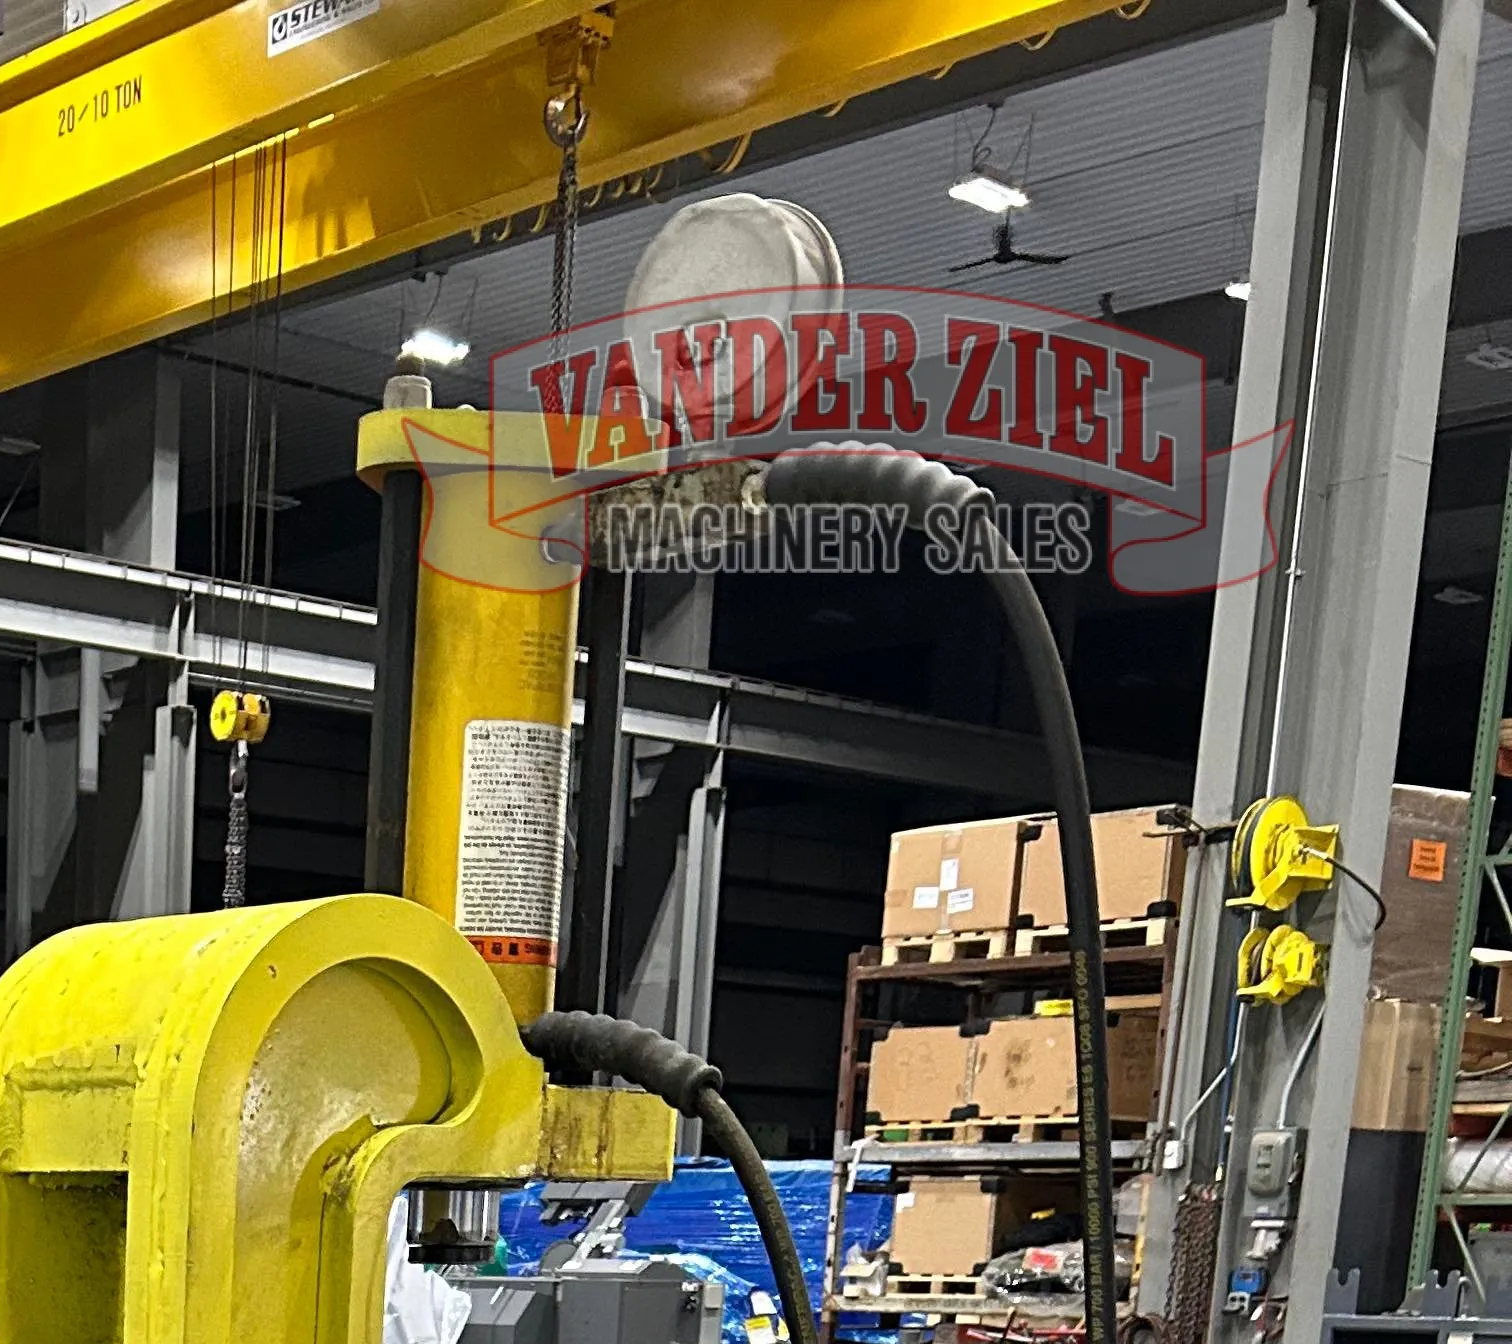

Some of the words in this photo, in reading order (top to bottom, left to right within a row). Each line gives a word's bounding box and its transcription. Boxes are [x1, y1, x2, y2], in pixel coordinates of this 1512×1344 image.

[115, 75, 142, 112] TON
[1081, 1086, 1096, 1141] SERIES
[1085, 1173, 1099, 1198] PSI
[1086, 1202, 1101, 1241] 10000
[1088, 1253, 1102, 1285] BAR
[1090, 1288, 1104, 1313] 700
[1090, 1316, 1105, 1341] WP
